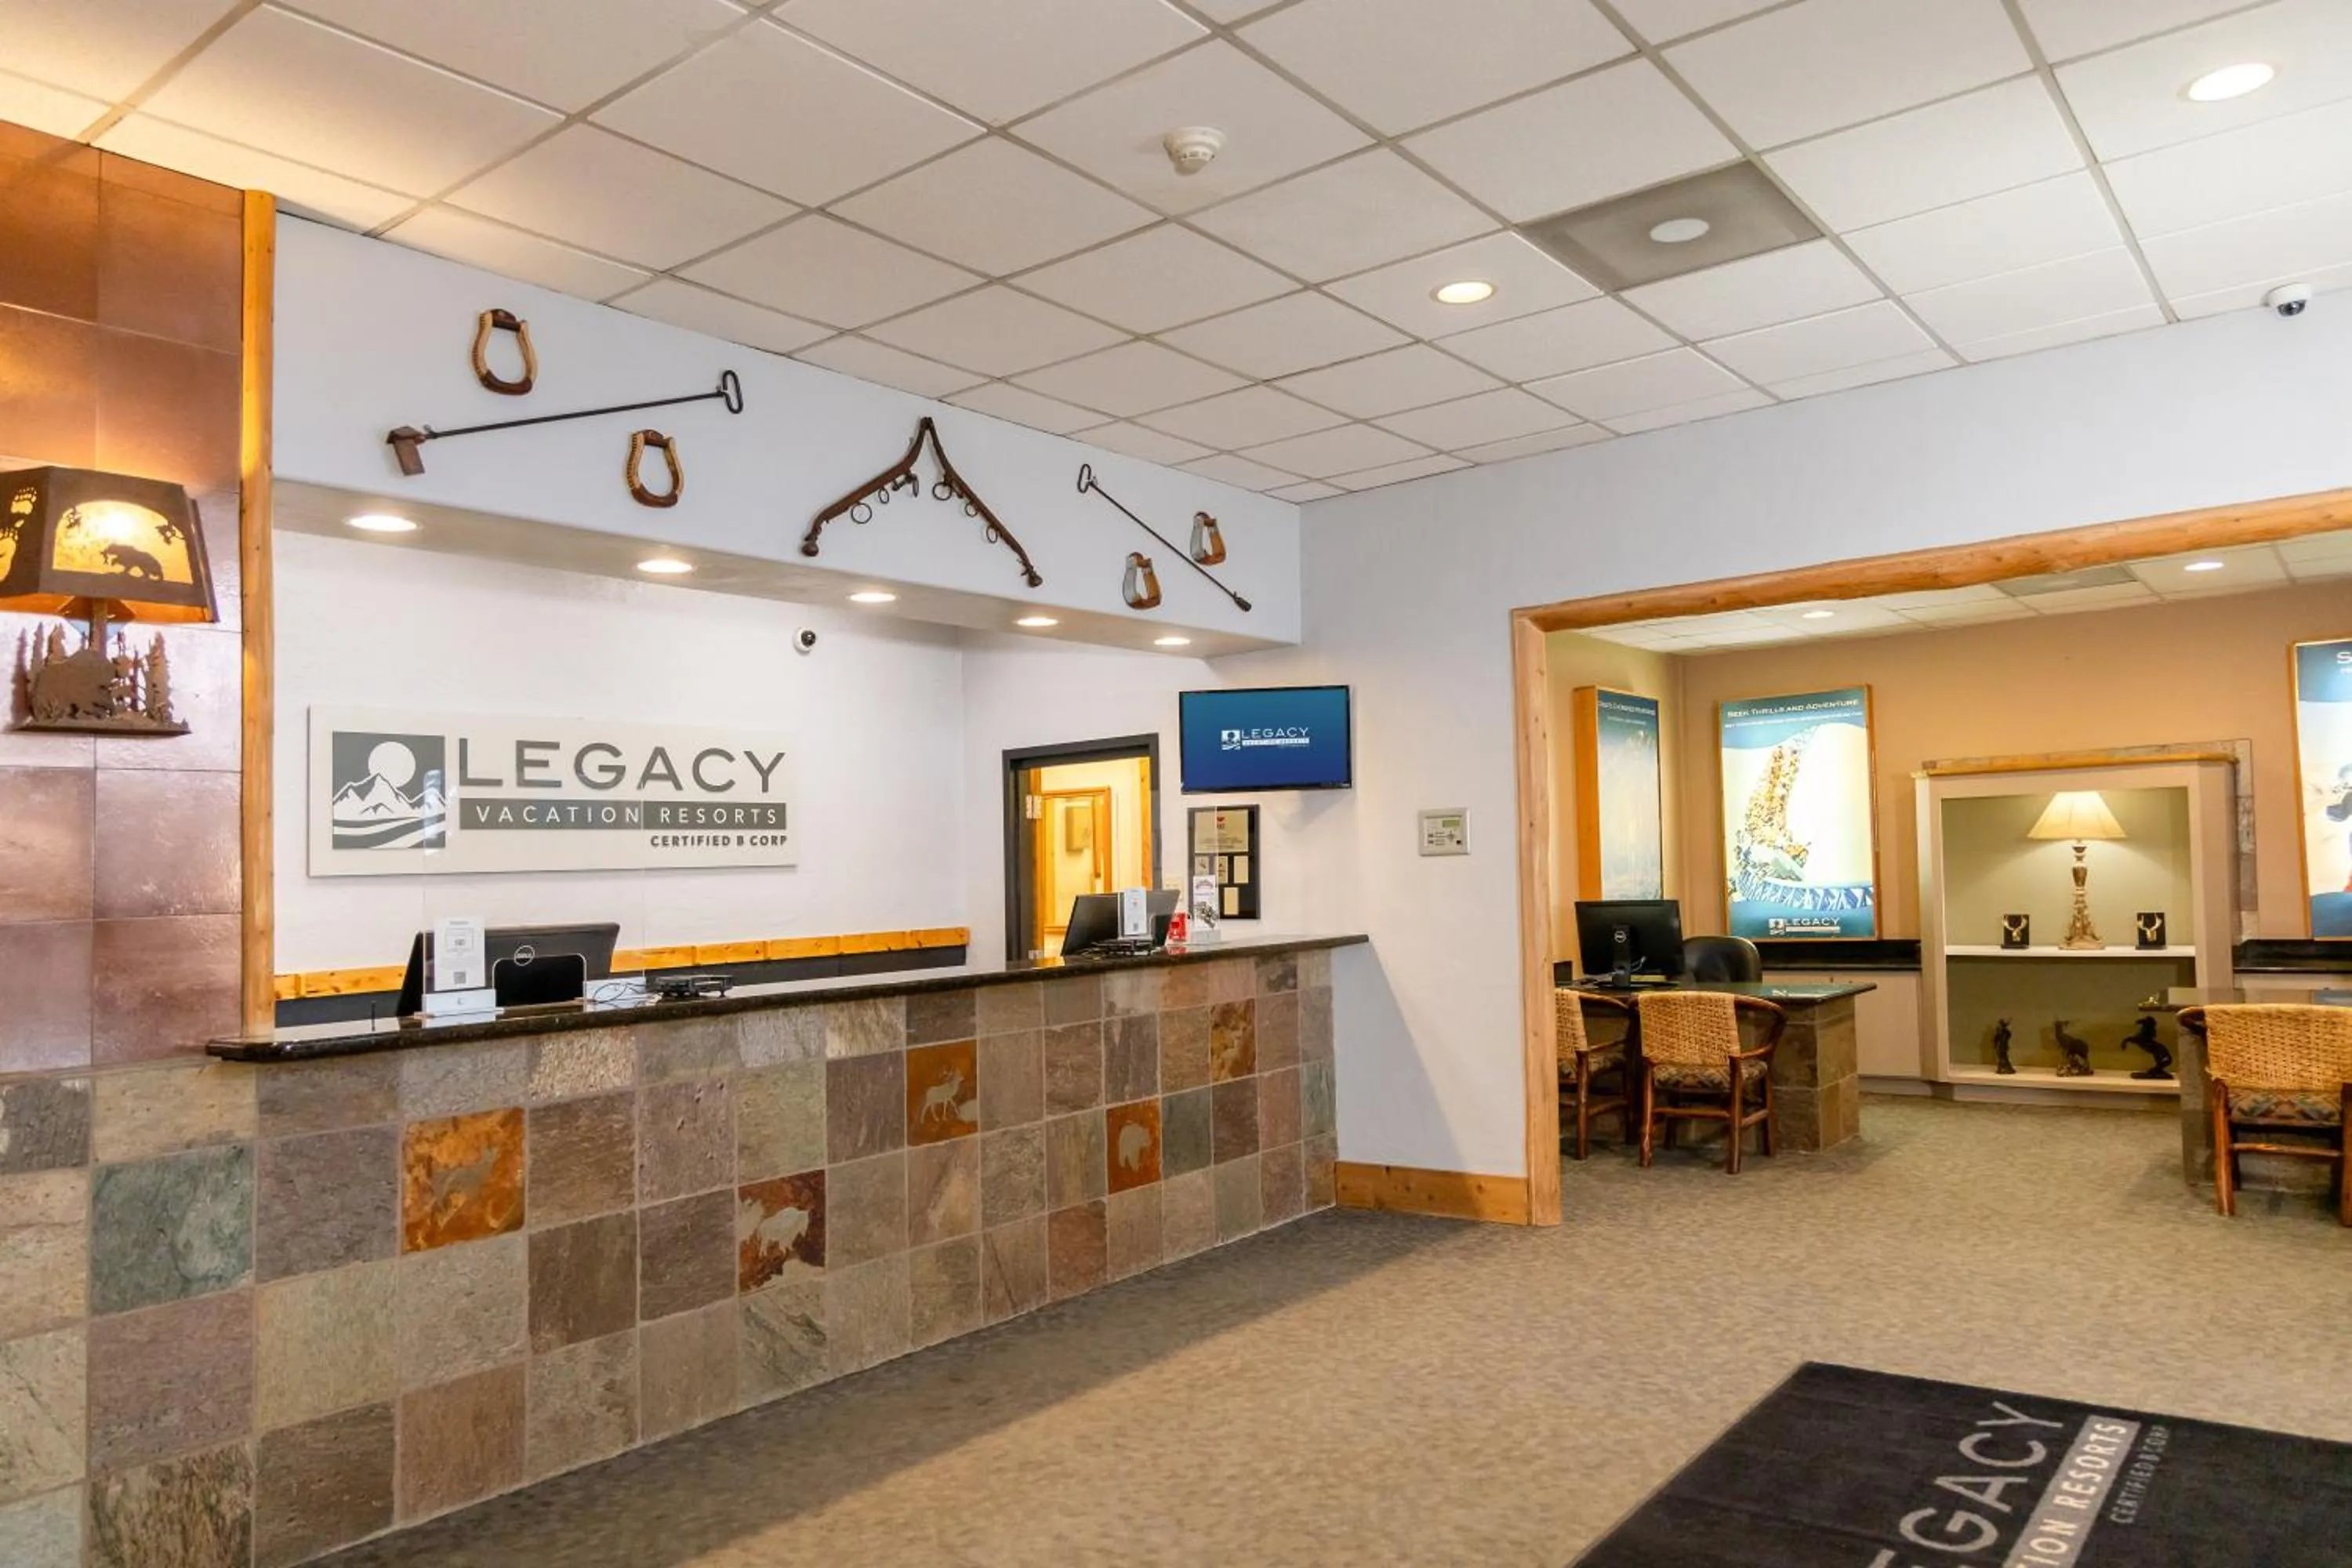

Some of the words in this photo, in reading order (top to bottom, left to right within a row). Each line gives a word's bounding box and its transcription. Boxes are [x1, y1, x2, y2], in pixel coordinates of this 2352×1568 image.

[1241, 727, 1308, 739] LEGACY
[1727, 710, 1749, 718] SEEK
[458, 737, 786, 793] LEGACY
[476, 804, 640, 824] VACATION
[660, 807, 778, 825] RESORTS
[650, 835, 731, 847] CERTIFIED
[736, 835, 744, 846] B
[750, 835, 787, 846] CORP
[1869, 1400, 2063, 1568] GACY
[2109, 1461, 2154, 1523] CERTIFIED
[2142, 1424, 2169, 1453] CORP
[2015, 1519, 2078, 1568] ION
[2053, 1422, 2128, 1510] RESORTS
